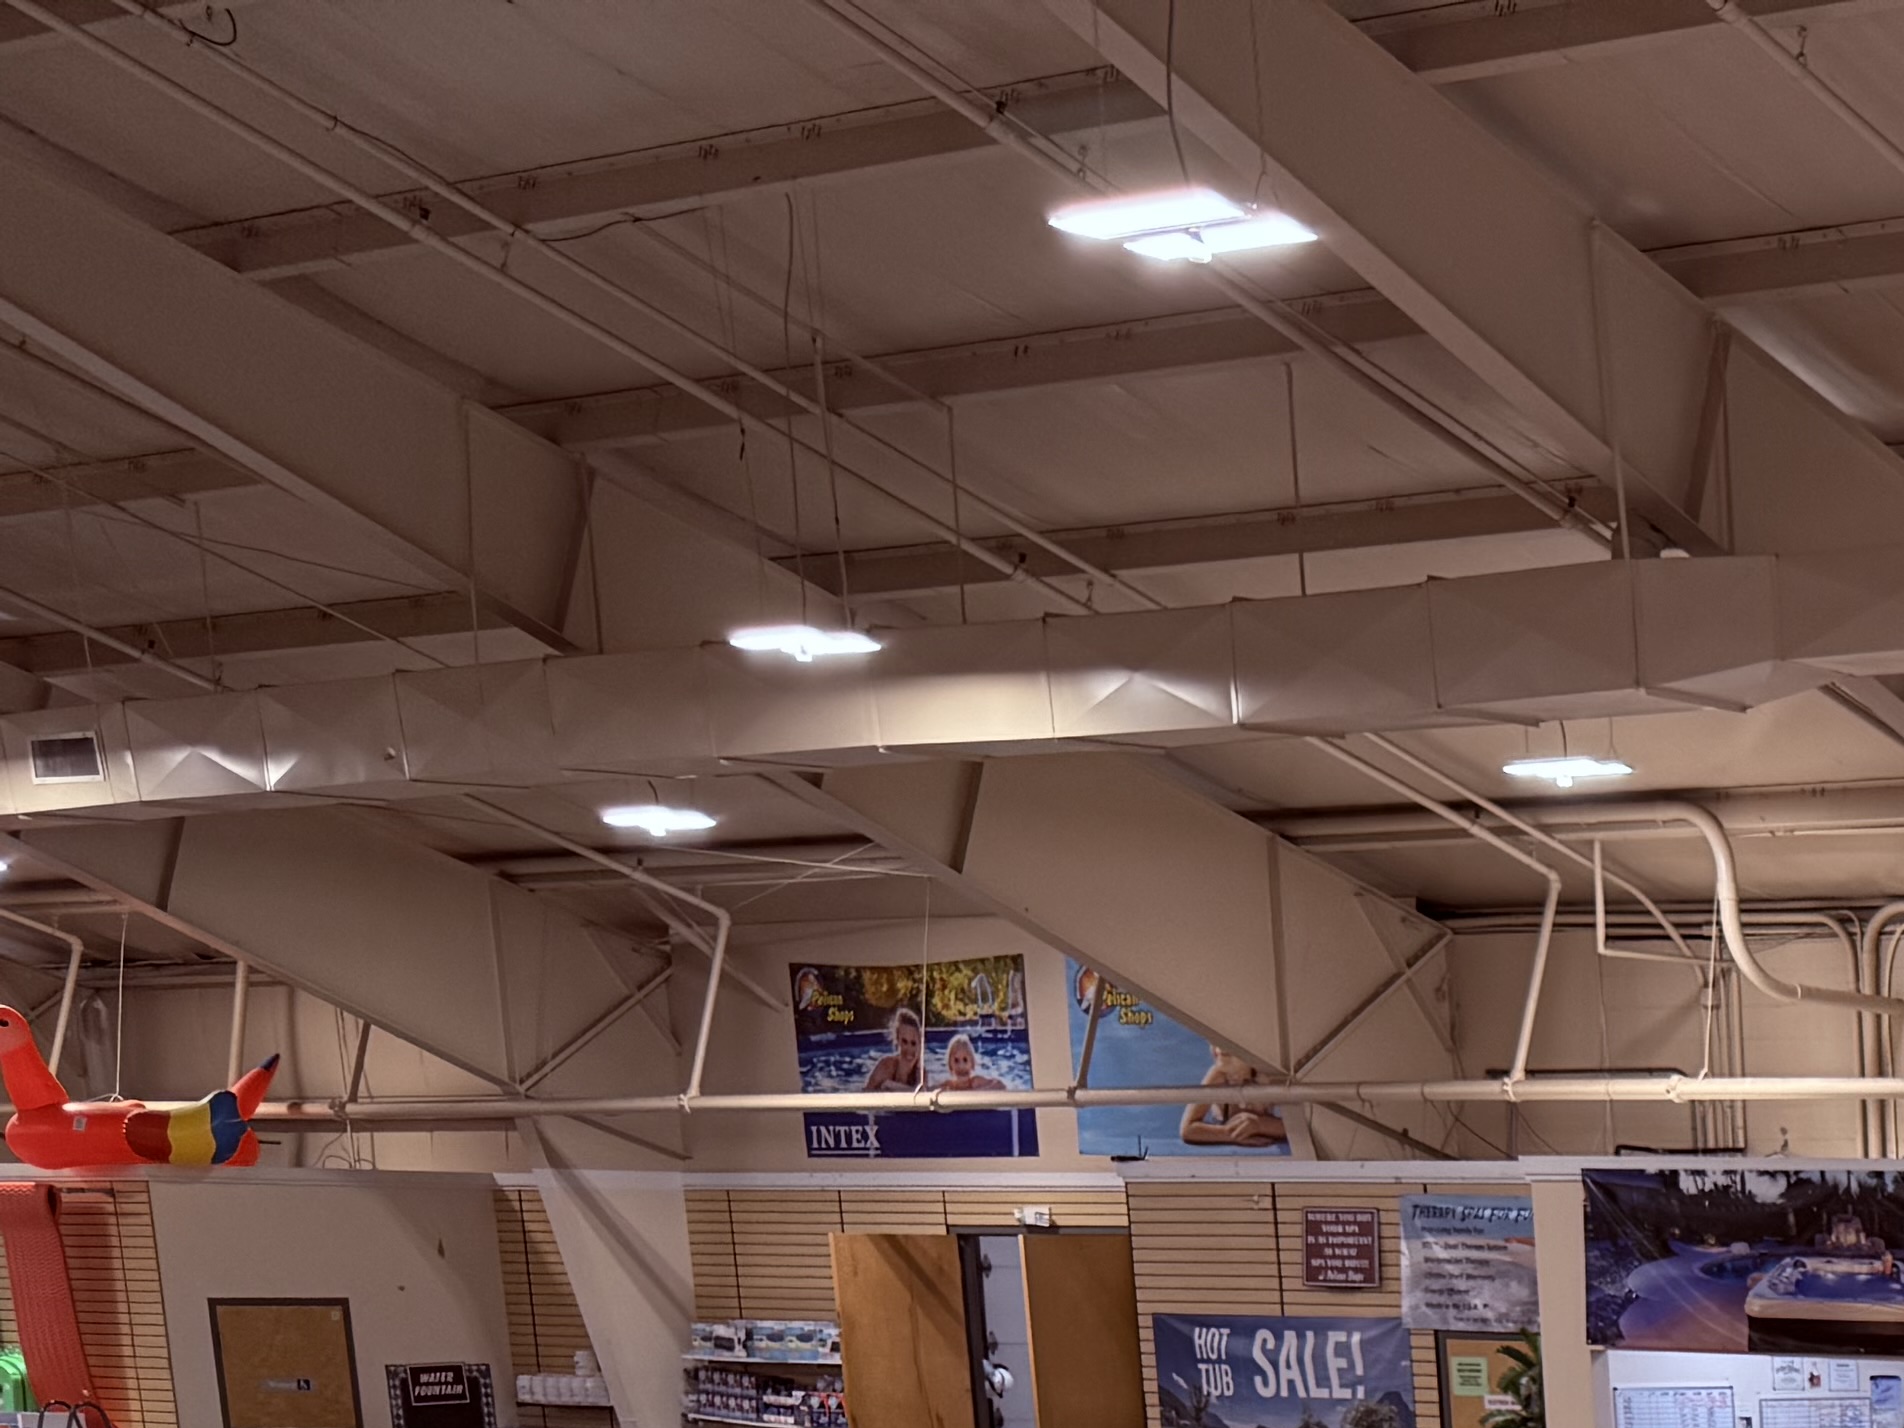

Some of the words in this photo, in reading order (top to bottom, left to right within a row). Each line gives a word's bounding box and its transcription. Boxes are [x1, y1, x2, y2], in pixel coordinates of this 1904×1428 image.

[810, 1124, 881, 1149] INTEX
[1194, 1327, 1231, 1360] HOT
[1197, 1363, 1234, 1397] TUB
[1252, 1328, 1365, 1400] SALE!
